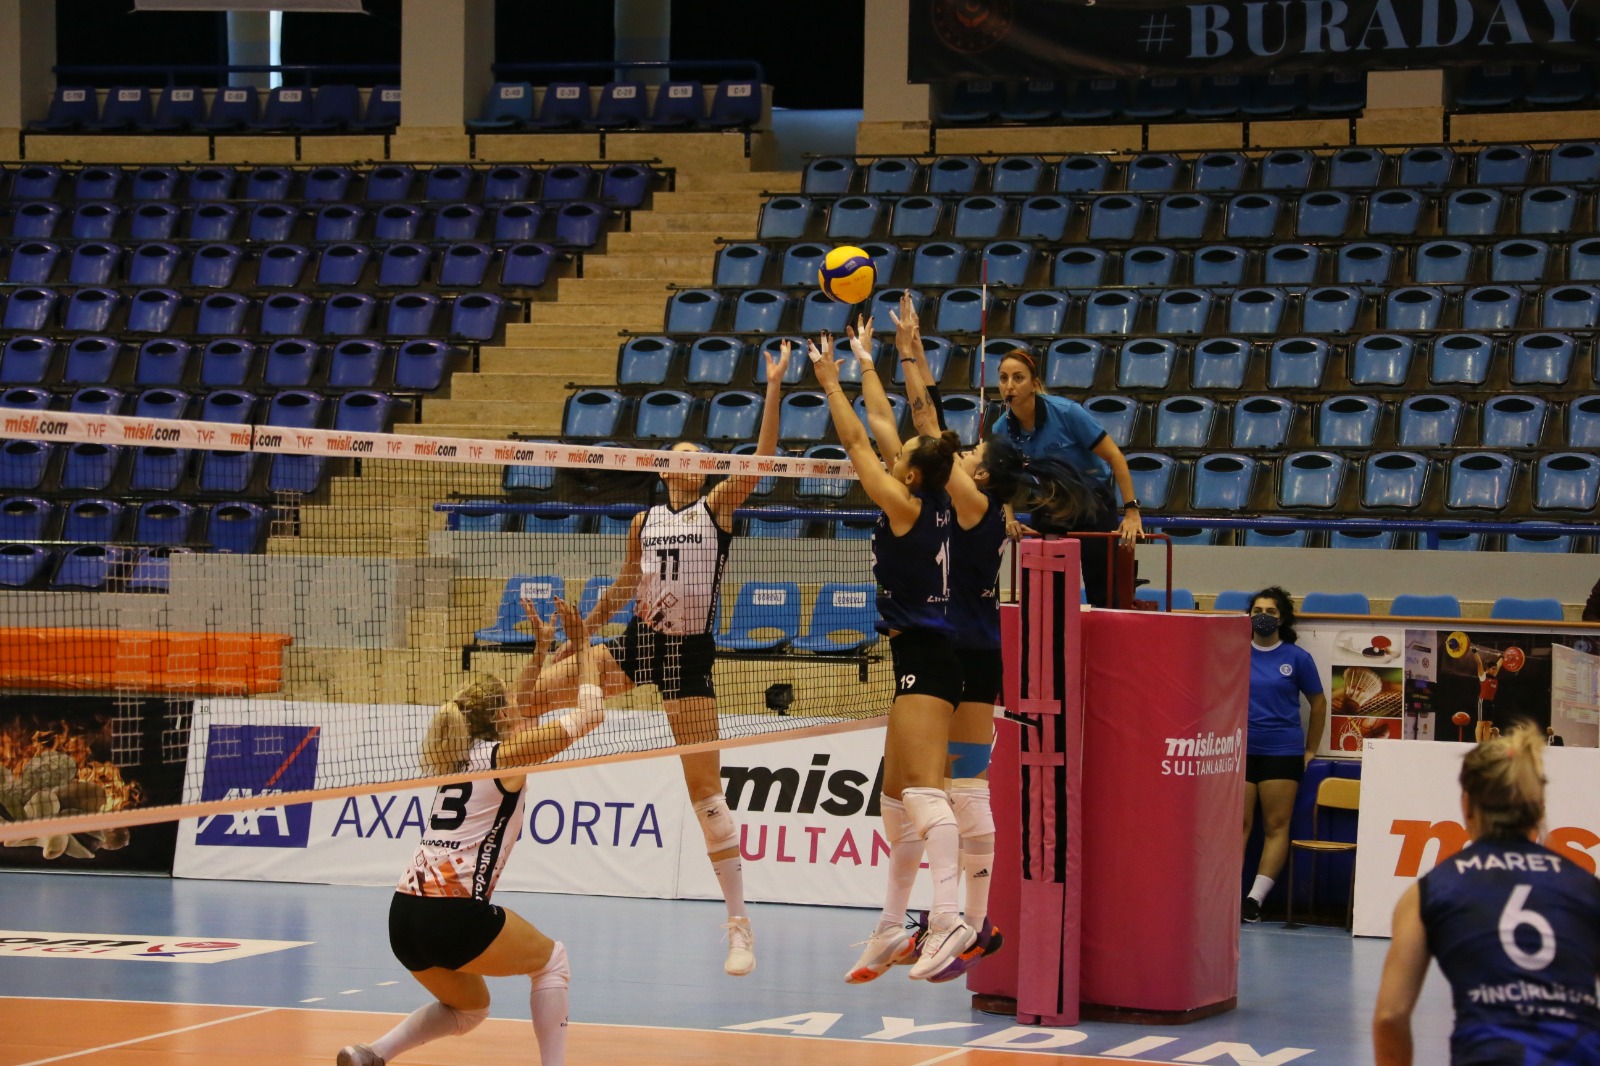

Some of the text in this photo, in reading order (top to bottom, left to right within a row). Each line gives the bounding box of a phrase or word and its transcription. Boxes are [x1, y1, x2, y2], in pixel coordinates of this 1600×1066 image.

[1137, 0, 1600, 59] #BURADAY
[5, 415, 68, 435] misli.com
[87, 422, 106, 438] TVF
[123, 424, 180, 442] misli.com
[197, 429, 215, 444] TVF
[296, 434, 313, 449] TVF
[327, 435, 374, 452] misli.com
[387, 440, 402, 454] TVF
[414, 440, 457, 457] misli.com
[469, 446, 483, 459] TVF
[494, 445, 534, 461] misli.com
[544, 450, 558, 463] TVF
[568, 448, 604, 464] misli.com
[614, 453, 626, 466] TVF
[636, 453, 670, 469] misli.com
[679, 457, 690, 469] TVF
[699, 456, 731, 471] misli.com
[739, 460, 750, 471] TVF
[758, 460, 788, 473] misli.com
[794, 462, 806, 474] TVF
[812, 462, 841, 475] misli.com
[656, 548, 680, 581] 11
[900, 673, 916, 690] 19
[1165, 732, 1234, 757] misli.com
[431, 781, 473, 831] 3
[720, 753, 885, 817] misl
[331, 795, 425, 839] AXA
[1454, 851, 1563, 874] MARET
[1498, 883, 1557, 971] 6
[719, 1012, 1317, 1066] AYDIN
